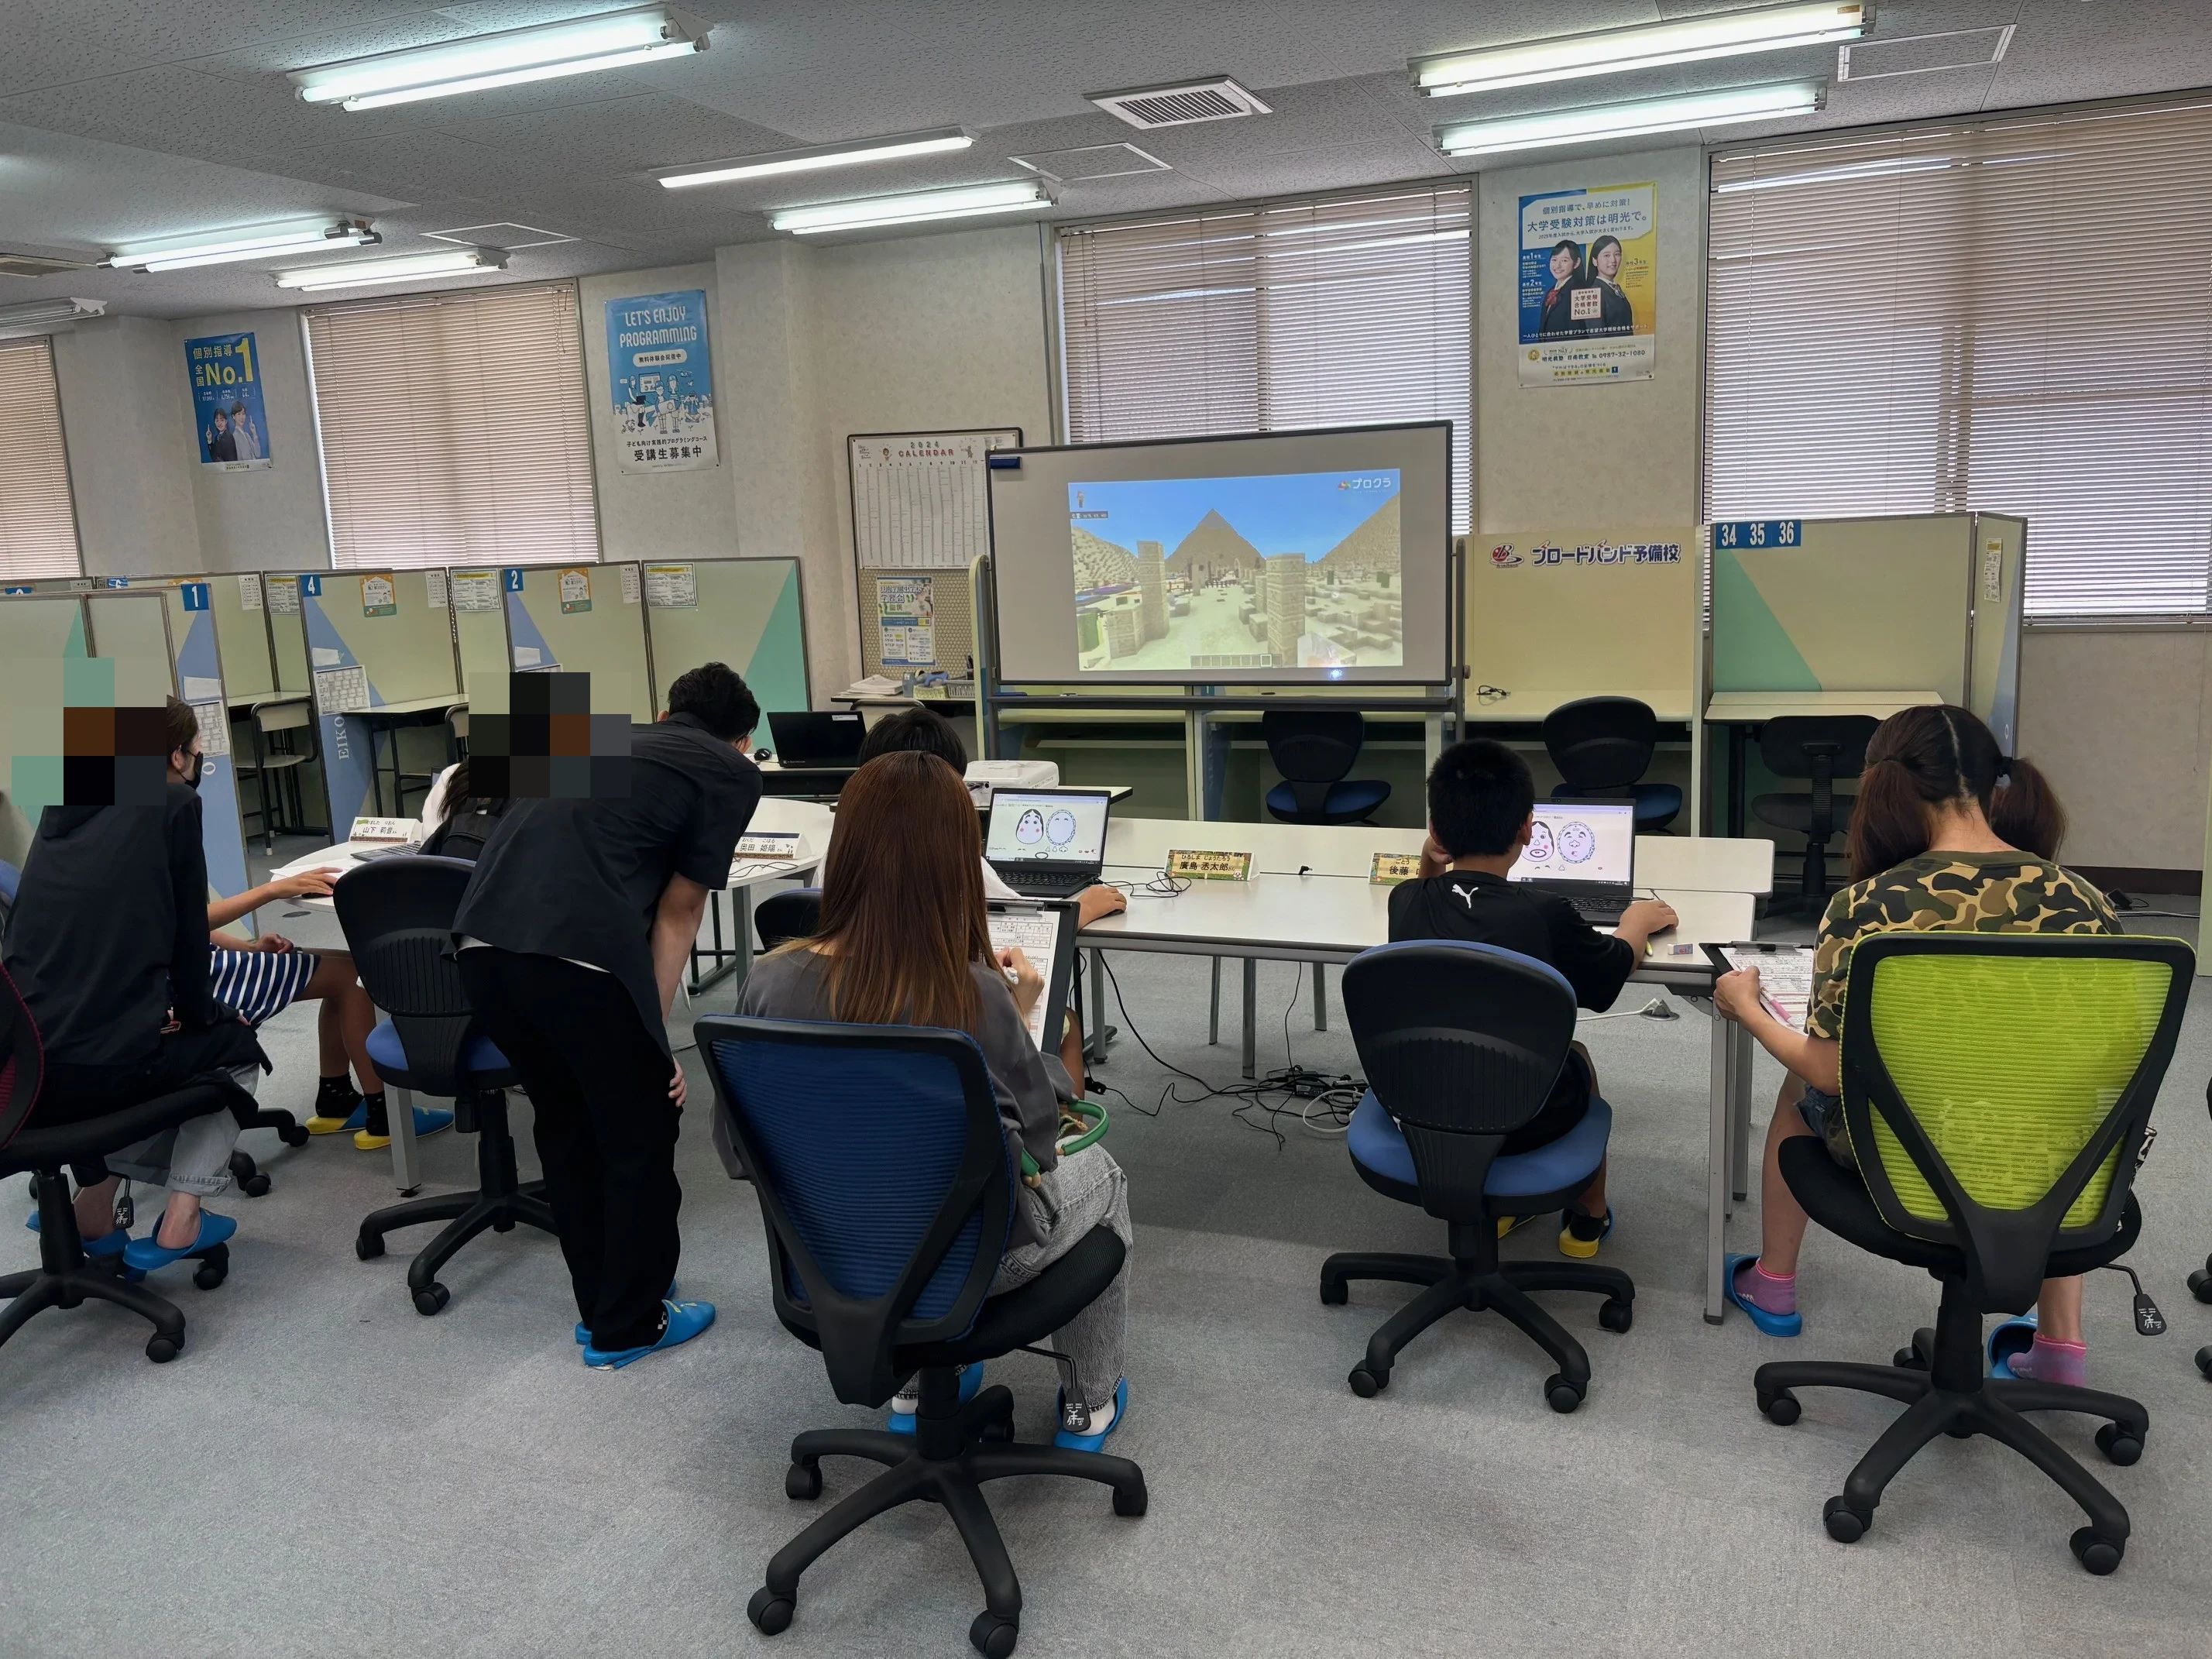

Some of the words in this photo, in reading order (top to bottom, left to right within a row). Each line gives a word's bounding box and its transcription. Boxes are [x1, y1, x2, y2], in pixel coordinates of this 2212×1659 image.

[1527, 211, 1647, 232] 大学受験対策は明光で。
[625, 309, 651, 327] LET'S
[653, 305, 686, 324] ENJOY
[620, 325, 697, 348] PROGRAMMING
[193, 344, 232, 359] 個別指導
[1599, 349, 1646, 359] 0987-32-1080
[205, 338, 253, 386] No.1
[195, 364, 204, 386] 全国
[634, 445, 702, 462] 受講生募集中
[898, 448, 954, 457] CALENDAR
[1352, 477, 1391, 489] プロクラ
[1721, 524, 1736, 546] 34
[1750, 523, 1765, 545] 35
[1778, 521, 1794, 544] 36
[1531, 541, 1680, 565] ブロードバンド予備校
[307, 575, 315, 594] 4
[511, 570, 518, 589] 2
[191, 586, 198, 607] 1
[334, 716, 349, 760] EIKO
[1179, 861, 1198, 871] 廣島
[1389, 865, 1410, 876] 後藤
